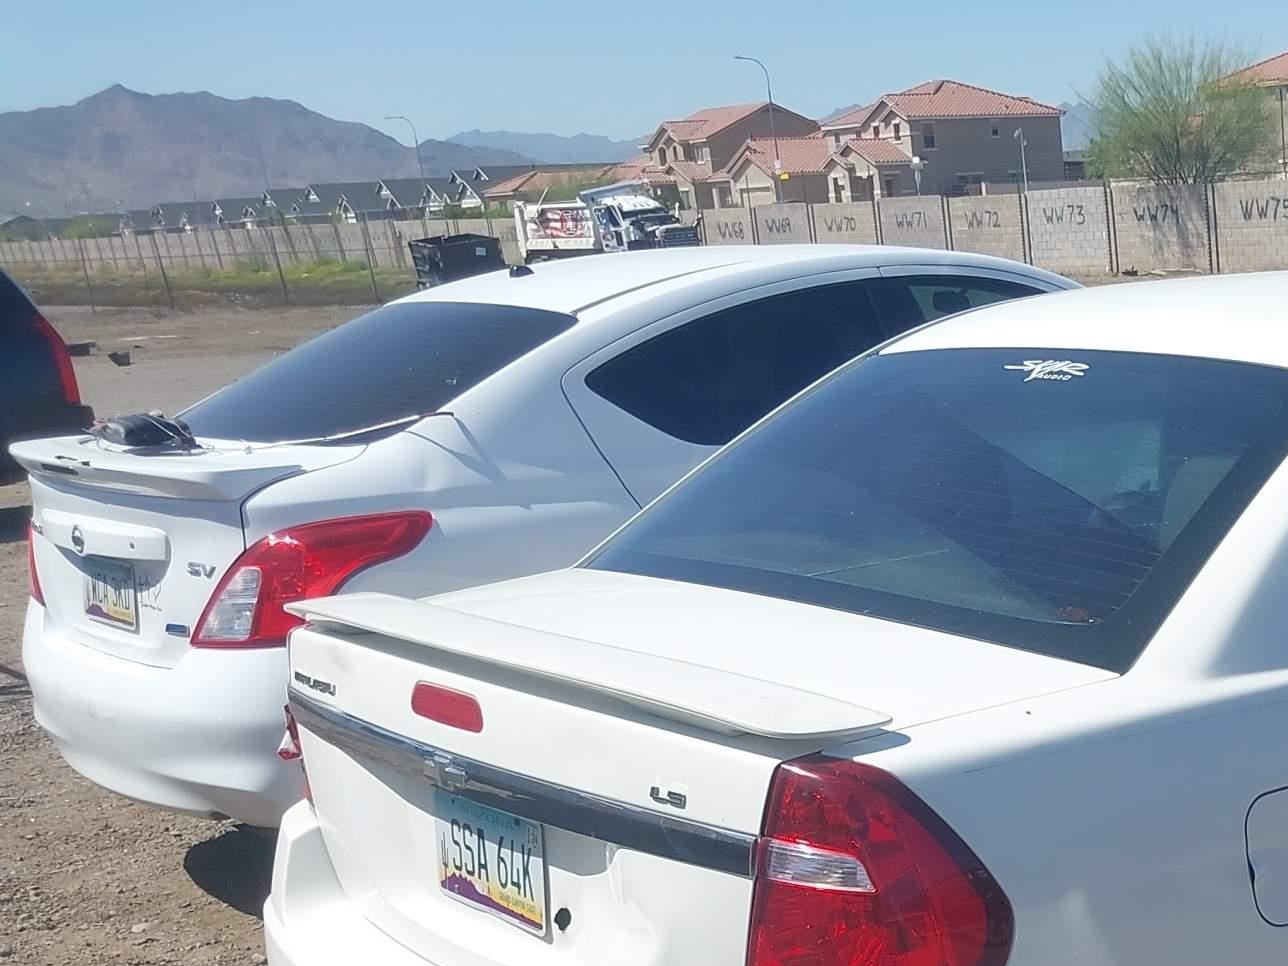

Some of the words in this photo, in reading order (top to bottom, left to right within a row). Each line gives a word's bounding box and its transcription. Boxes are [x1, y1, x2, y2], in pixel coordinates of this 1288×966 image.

[895, 211, 928, 229] WW71
[964, 209, 1001, 229] WW72
[1042, 204, 1086, 226] WW73
[1133, 203, 1180, 224] WW74
[718, 220, 745, 240] WW68
[765, 217, 792, 233] WW69
[824, 215, 857, 233] WW70
[187, 561, 216, 579] SV
[450, 818, 489, 883] SSA
[497, 835, 535, 902] 64K
